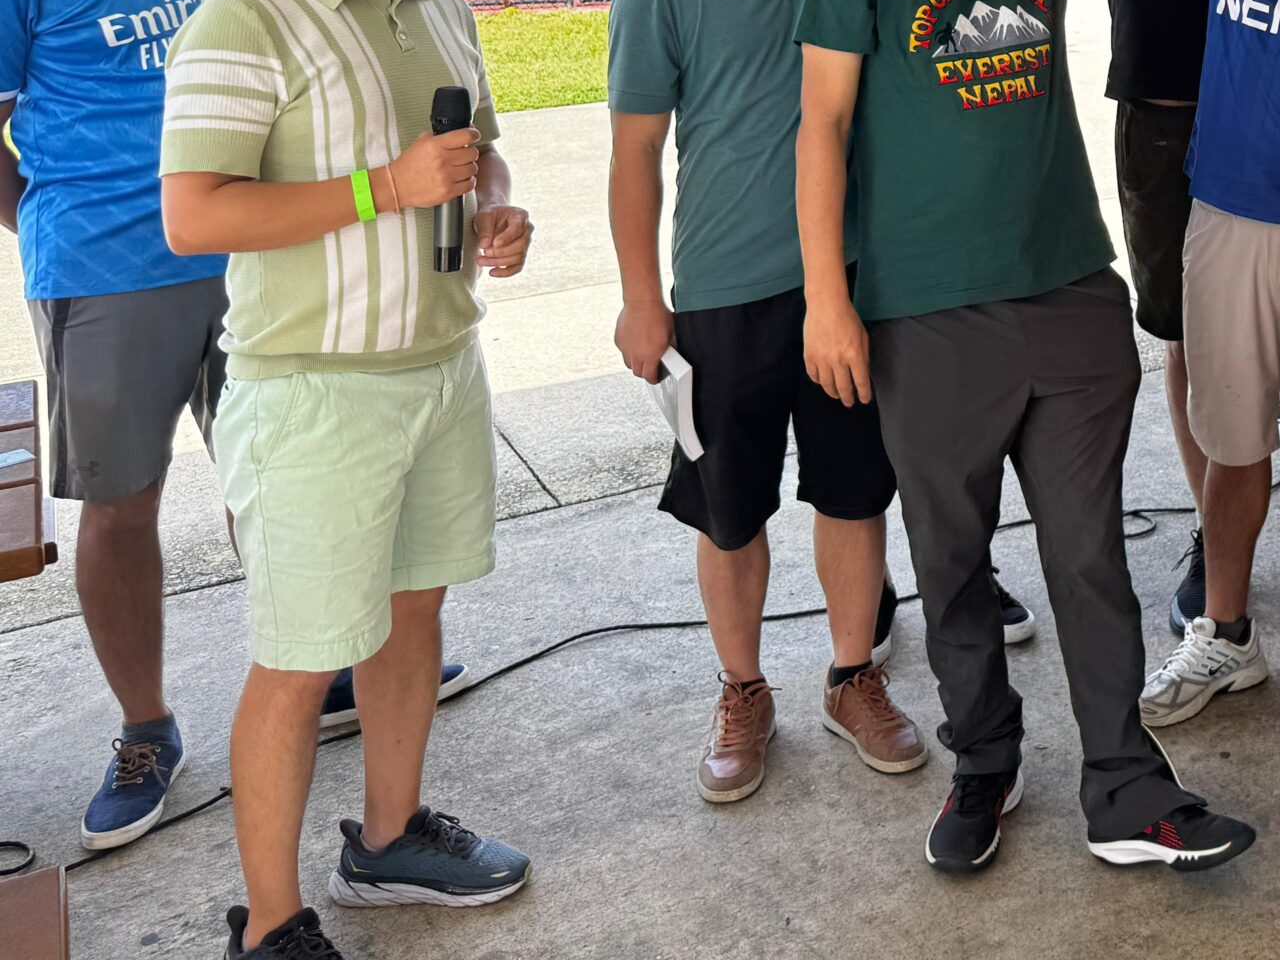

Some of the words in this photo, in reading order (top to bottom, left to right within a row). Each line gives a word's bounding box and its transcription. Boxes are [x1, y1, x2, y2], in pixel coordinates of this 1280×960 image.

[908, 3, 938, 54] TOP
[935, 43, 1051, 85] EVEREST
[957, 75, 1047, 111] NEPAL
